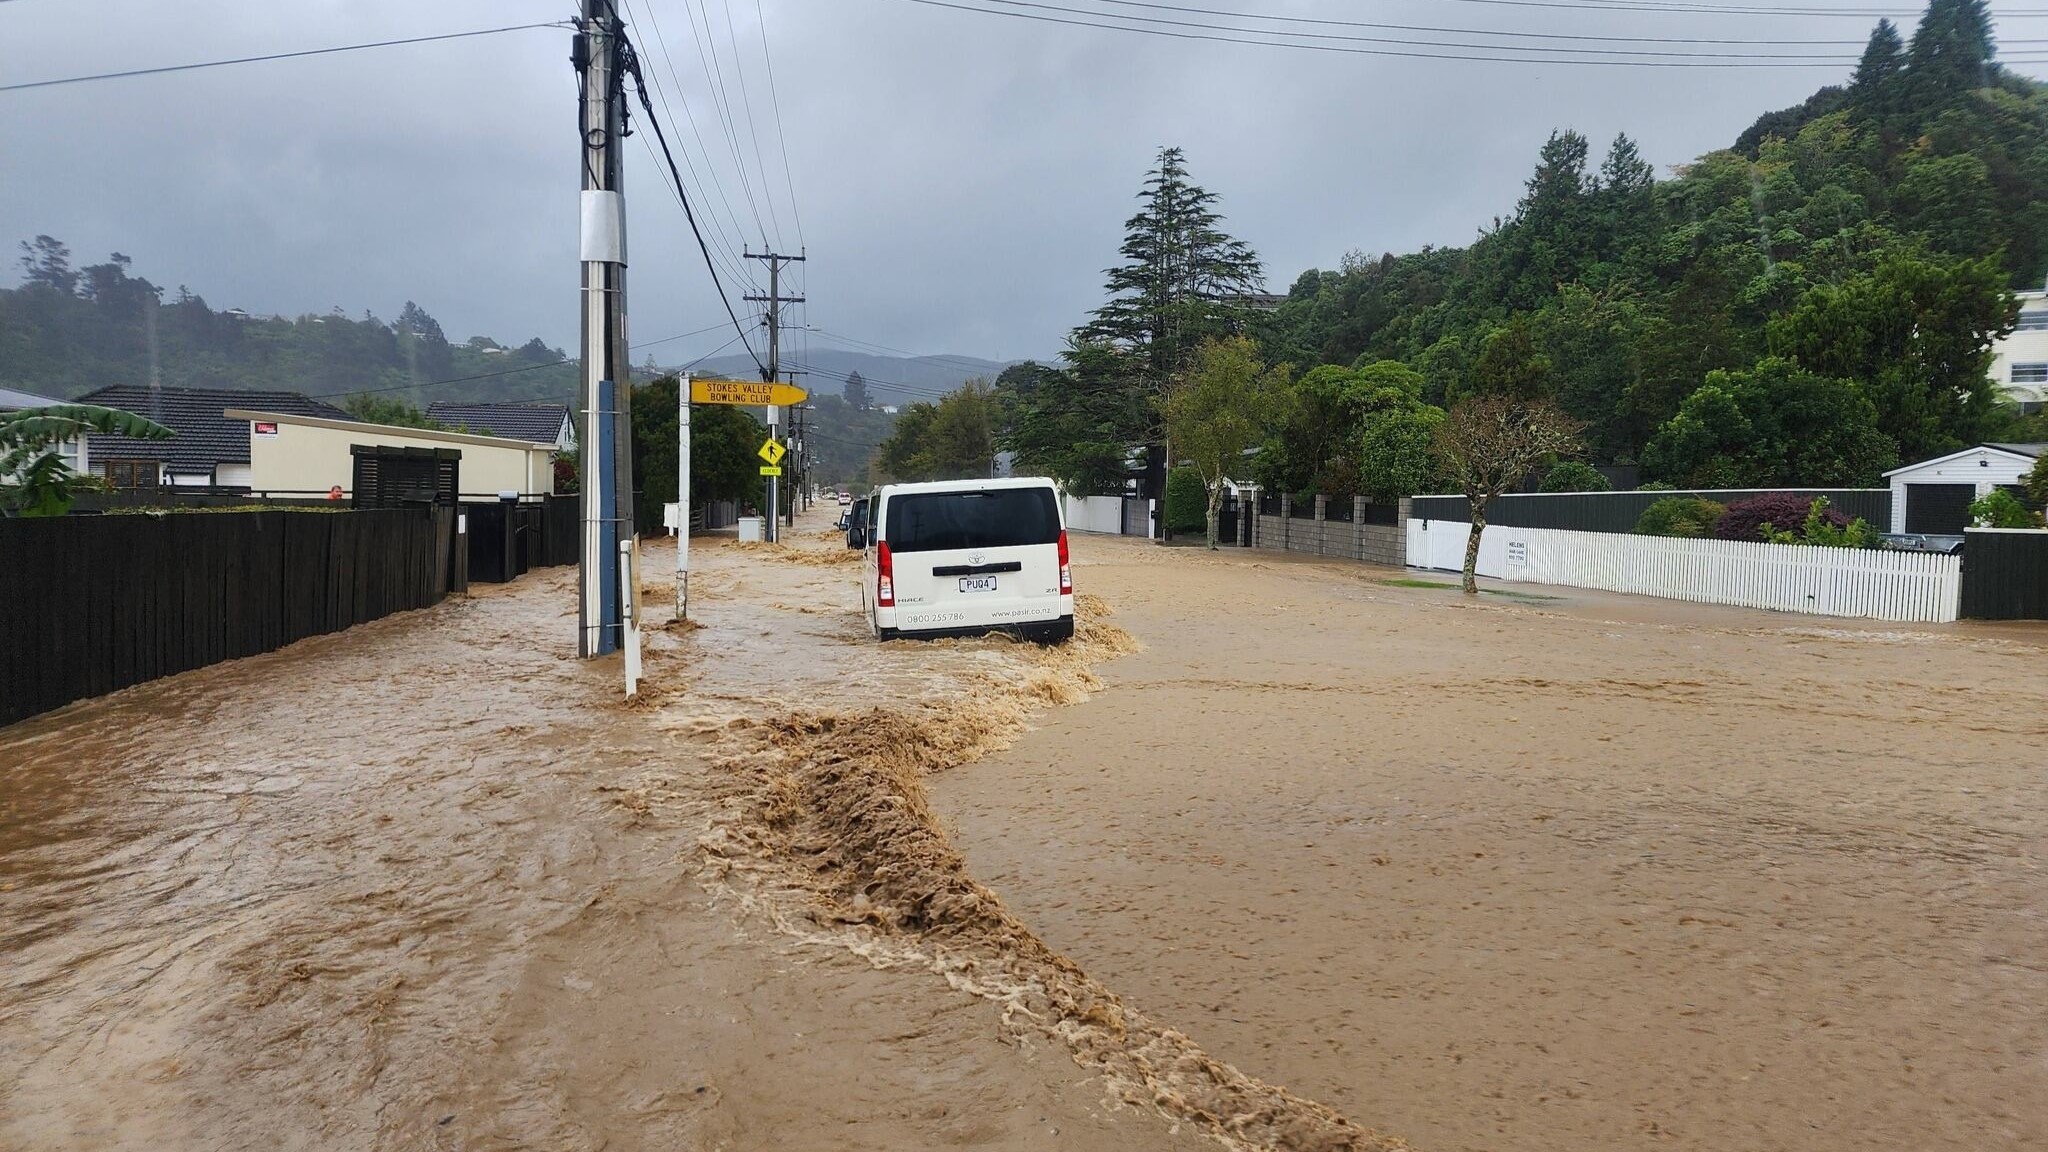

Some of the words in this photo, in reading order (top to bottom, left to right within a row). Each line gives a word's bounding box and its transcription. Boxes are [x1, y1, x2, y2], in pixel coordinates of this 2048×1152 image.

[706, 383, 738, 393] STOKES
[742, 384, 773, 394] VALLEY
[710, 393, 746, 402] BOWLING
[750, 394, 771, 403] CLUB
[966, 580, 989, 589] PUQ4
[907, 614, 930, 623] 0800
[932, 613, 947, 622] 255
[948, 613, 964, 621] 786
